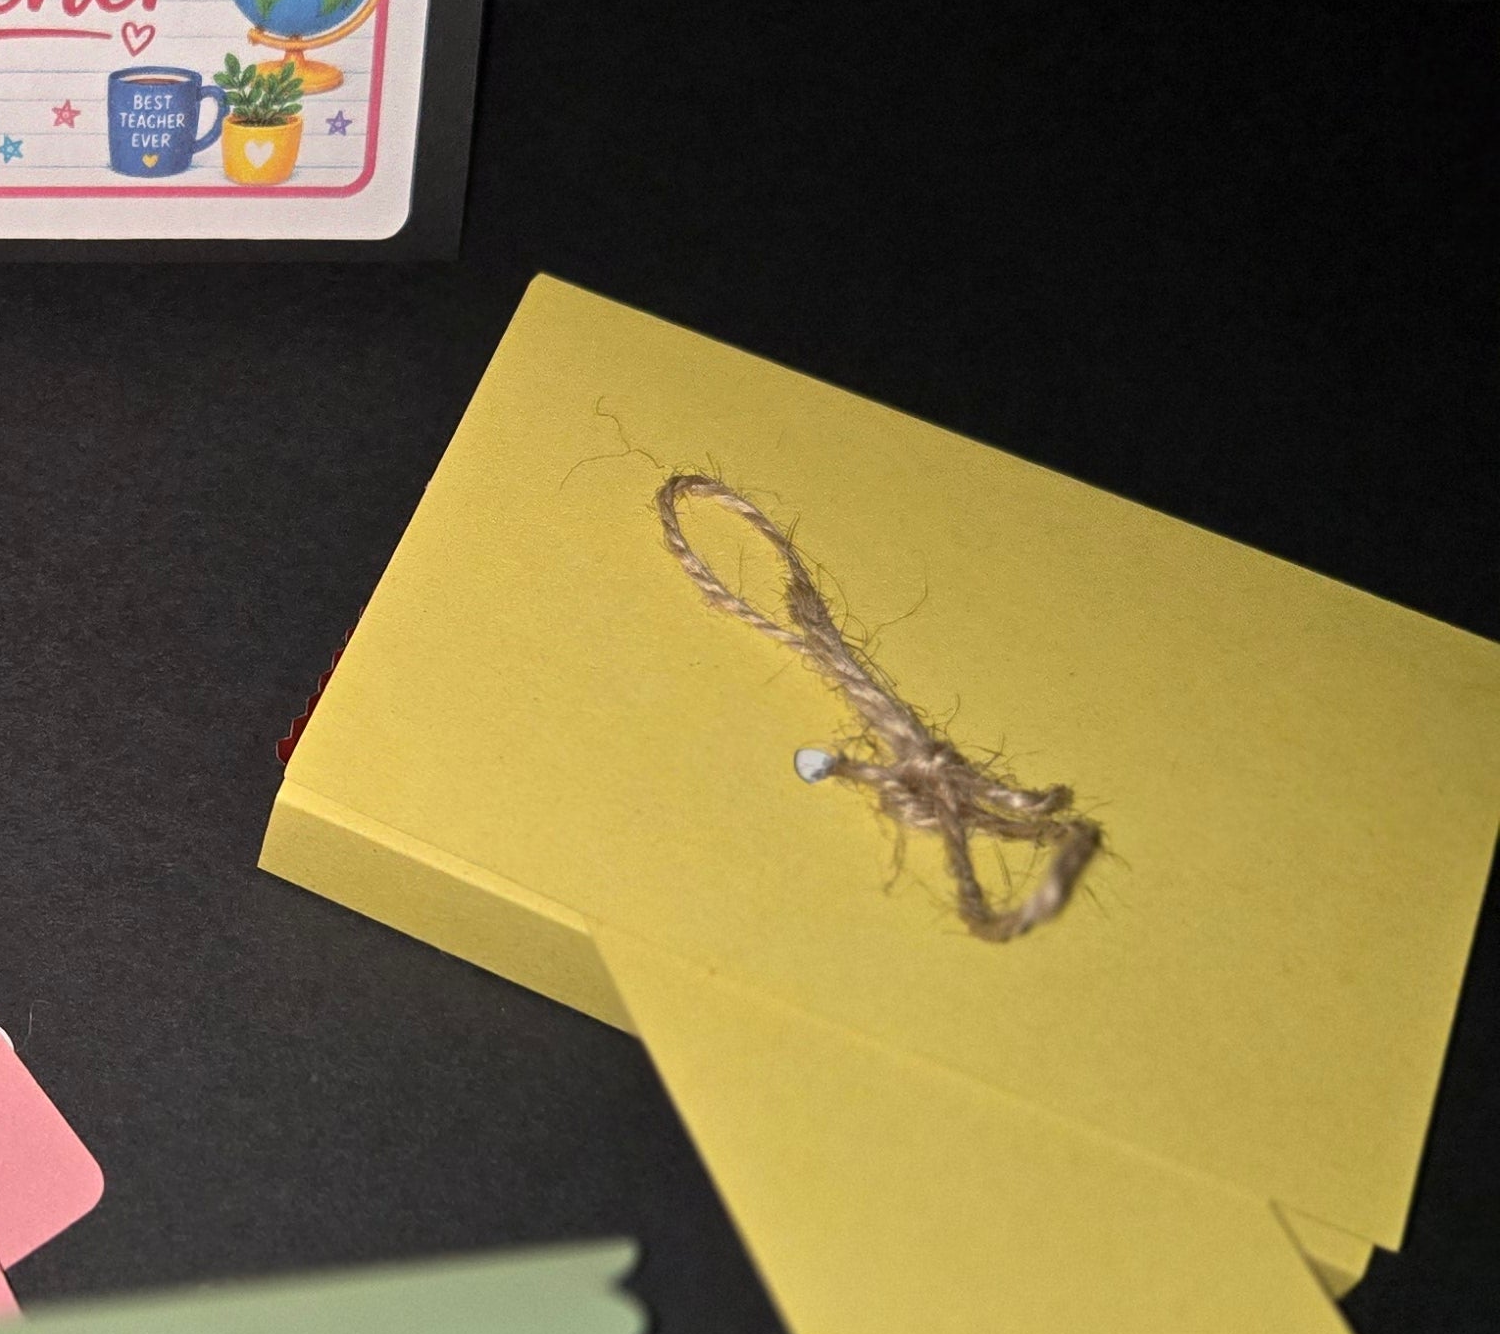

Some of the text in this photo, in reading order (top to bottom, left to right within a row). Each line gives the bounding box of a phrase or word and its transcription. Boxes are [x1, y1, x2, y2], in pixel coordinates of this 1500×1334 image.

[133, 94, 173, 110] BEST
[119, 112, 186, 129] TEACHER
[131, 133, 171, 148] EVER
